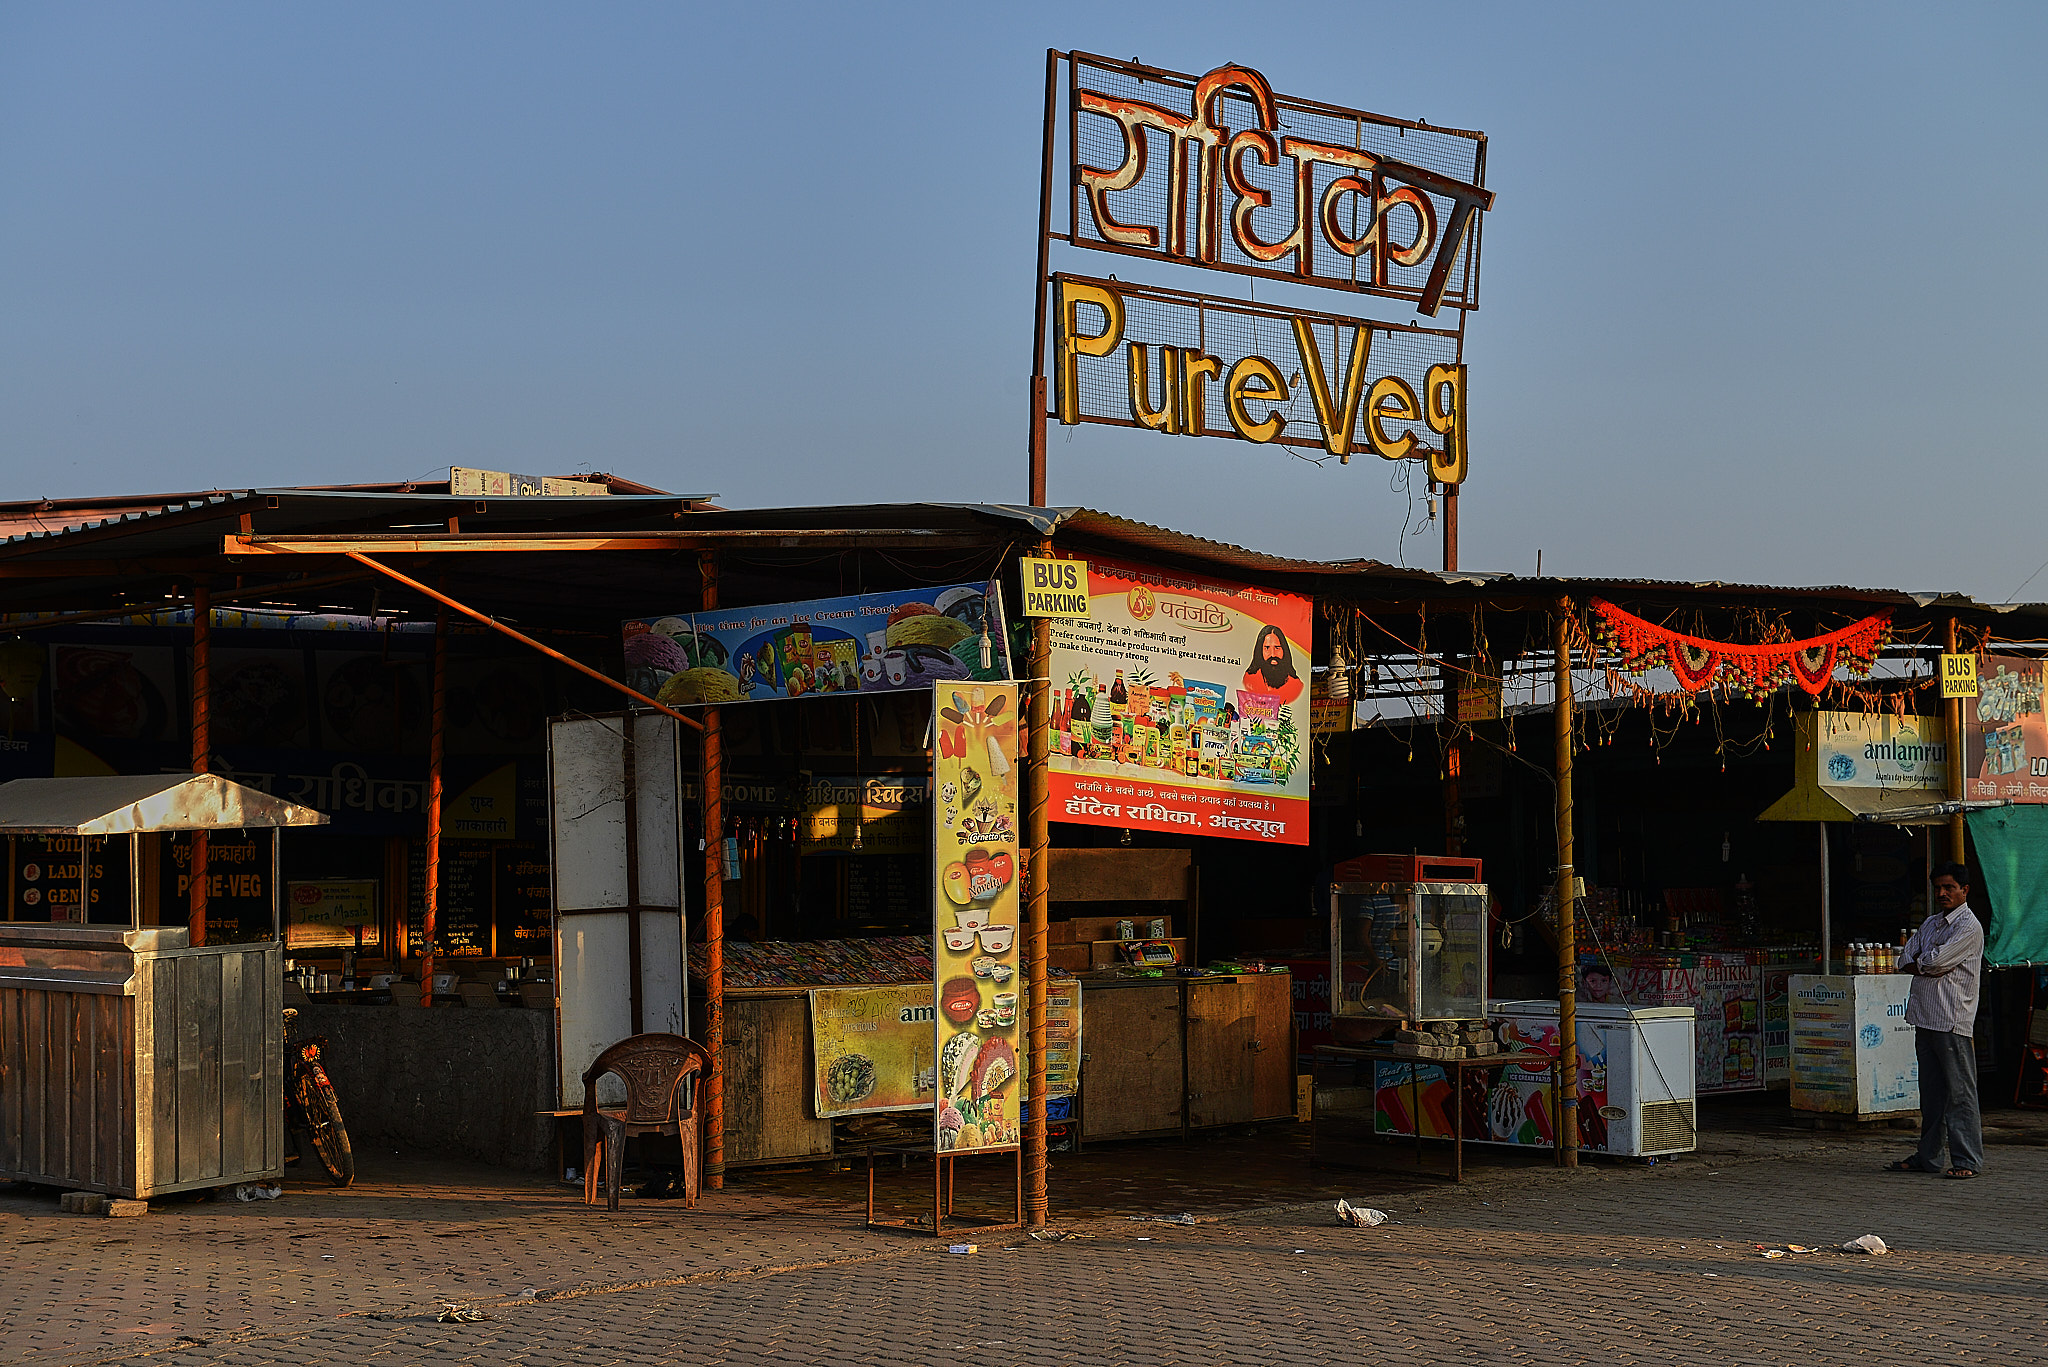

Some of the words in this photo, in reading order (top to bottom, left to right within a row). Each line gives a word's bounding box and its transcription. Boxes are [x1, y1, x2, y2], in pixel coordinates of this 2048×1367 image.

[1075, 62, 1497, 318] राधिका
[1055, 279, 1290, 444] Pure
[1290, 317, 1468, 484] Veg
[1034, 563, 1078, 589] BUS
[1028, 592, 1086, 613] PARKING
[1160, 601, 1226, 626] पतंजलि
[718, 619, 745, 630] time
[750, 616, 767, 632] for
[772, 616, 787, 625] an
[792, 613, 812, 624] Ice
[815, 609, 856, 621] Cream
[1050, 628, 1074, 640] Prefer
[1075, 632, 1104, 646] country
[1106, 638, 1127, 648] made
[1128, 640, 1160, 654] products
[1161, 646, 1178, 656] with
[1178, 650, 1197, 659] great
[1198, 653, 1212, 662] zest
[1213, 655, 1226, 664] and
[1227, 657, 1241, 666] zeal
[1050, 640, 1058, 648] to
[1059, 641, 1080, 651] make
[1081, 644, 1093, 653] the
[1095, 647, 1124, 659] country
[1125, 652, 1150, 664] strong
[1948, 658, 1970, 677] BUS
[1945, 678, 1976, 695] PARKING
[1075, 780, 1102, 792] पतंजलि
[1105, 784, 1113, 793] के
[1115, 785, 1134, 796] सबसे
[1160, 790, 1178, 801] सबसे
[2006, 781, 2024, 797] जेली
[1065, 794, 1121, 818] हॉटेल
[1126, 803, 1202, 829] राधिका,
[1209, 811, 1286, 838] अंदरसूल
[969, 830, 1001, 844] Cornetto
[48, 888, 100, 904] GENS
[178, 874, 261, 899] PRE-VEG
[969, 874, 1004, 898] Novelty
[299, 907, 330, 924] Jeera
[334, 902, 368, 921] Masala
[1622, 967, 1701, 995] JAIN
[1706, 965, 1752, 981] CHIKKI
[1797, 988, 1847, 1001] amlamrut
[843, 1021, 878, 1035] precious
[1379, 1063, 1401, 1078] Real
[1380, 1075, 1405, 1089] Real
